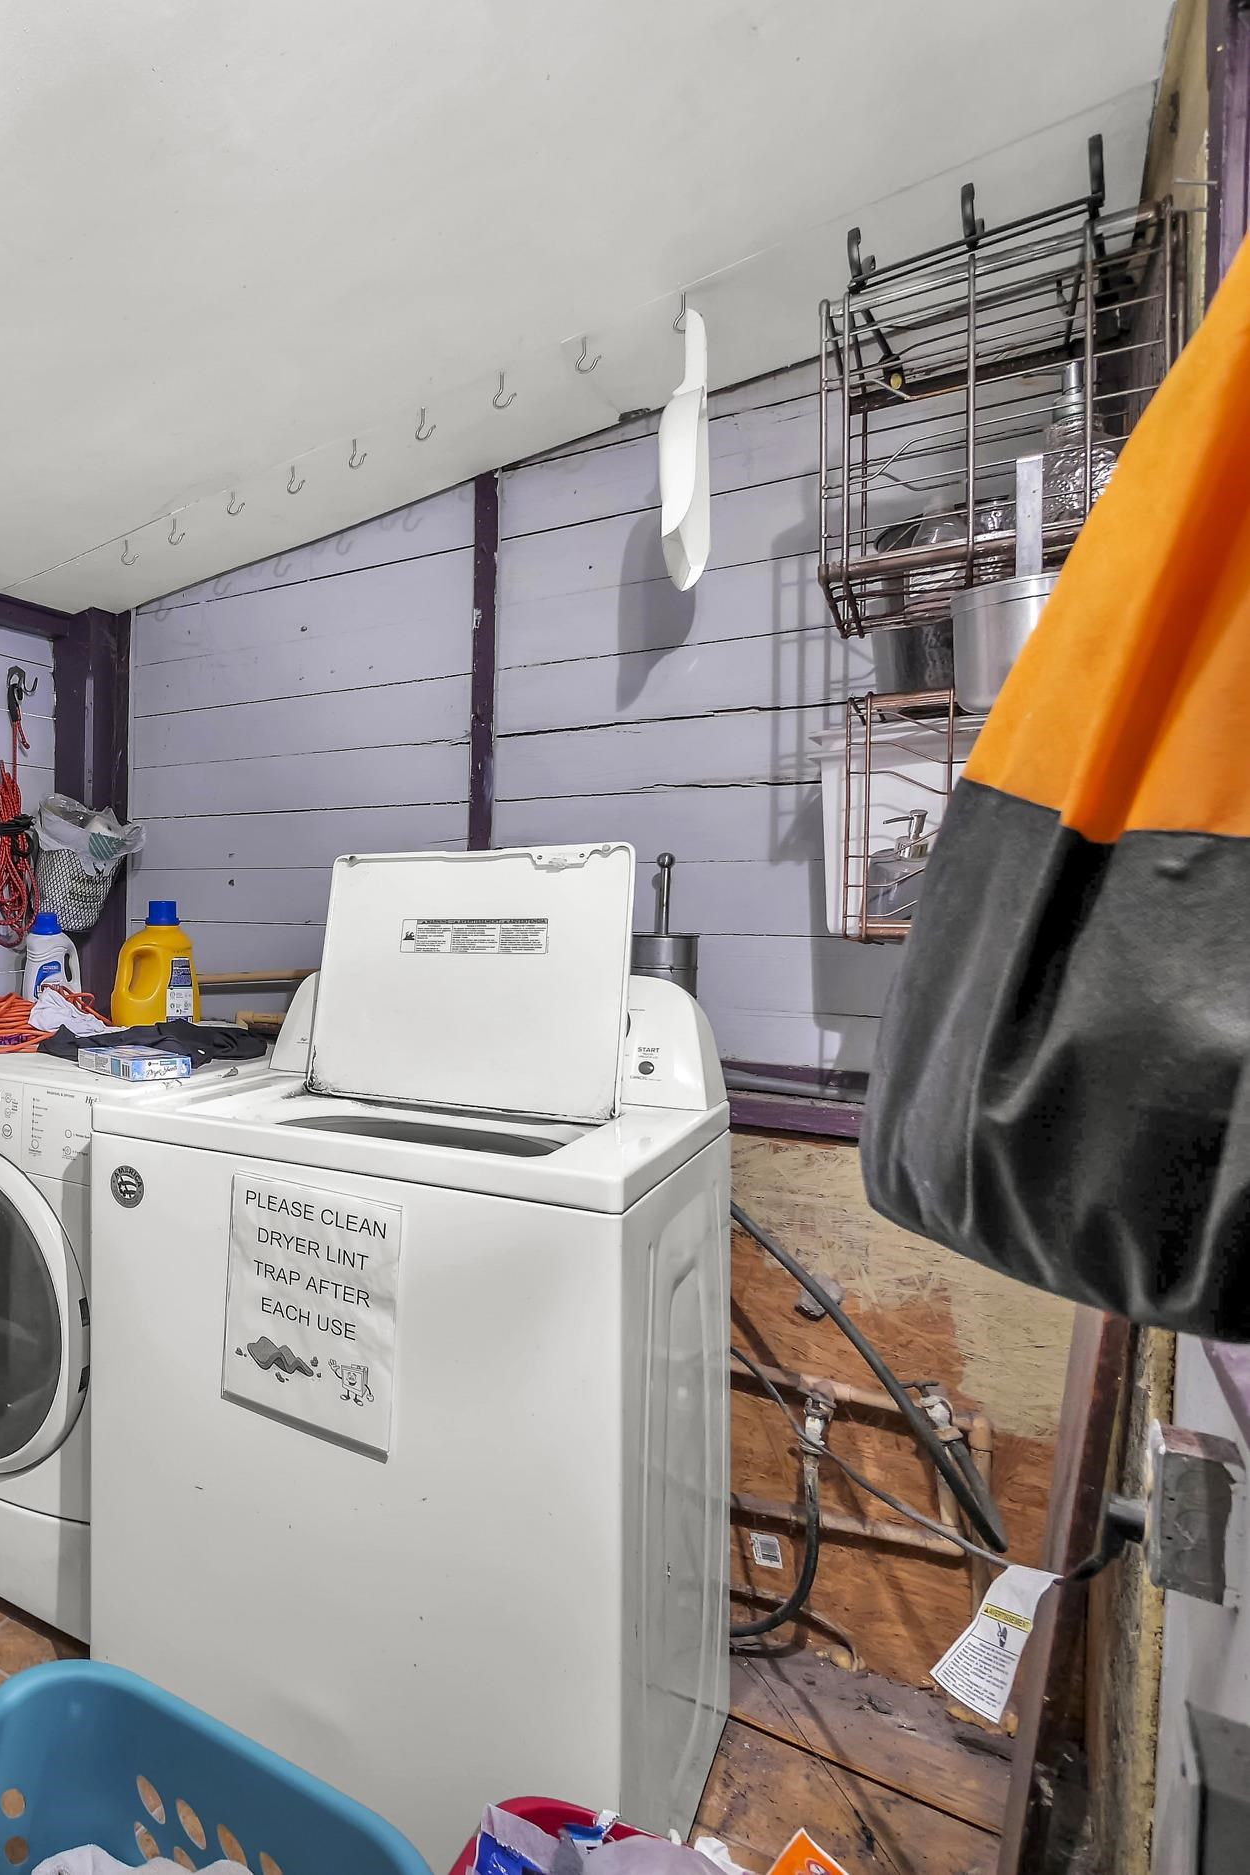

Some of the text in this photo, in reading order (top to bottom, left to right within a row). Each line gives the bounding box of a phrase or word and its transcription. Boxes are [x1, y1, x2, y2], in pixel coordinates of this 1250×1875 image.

[114, 1167, 143, 1188] AMERICA
[245, 1190, 387, 1240] PLEASE CLEAN
[257, 1227, 369, 1271] DRYER LINT
[253, 1259, 371, 1308] TRAP AFTER
[261, 1296, 357, 1341] EACH USE
